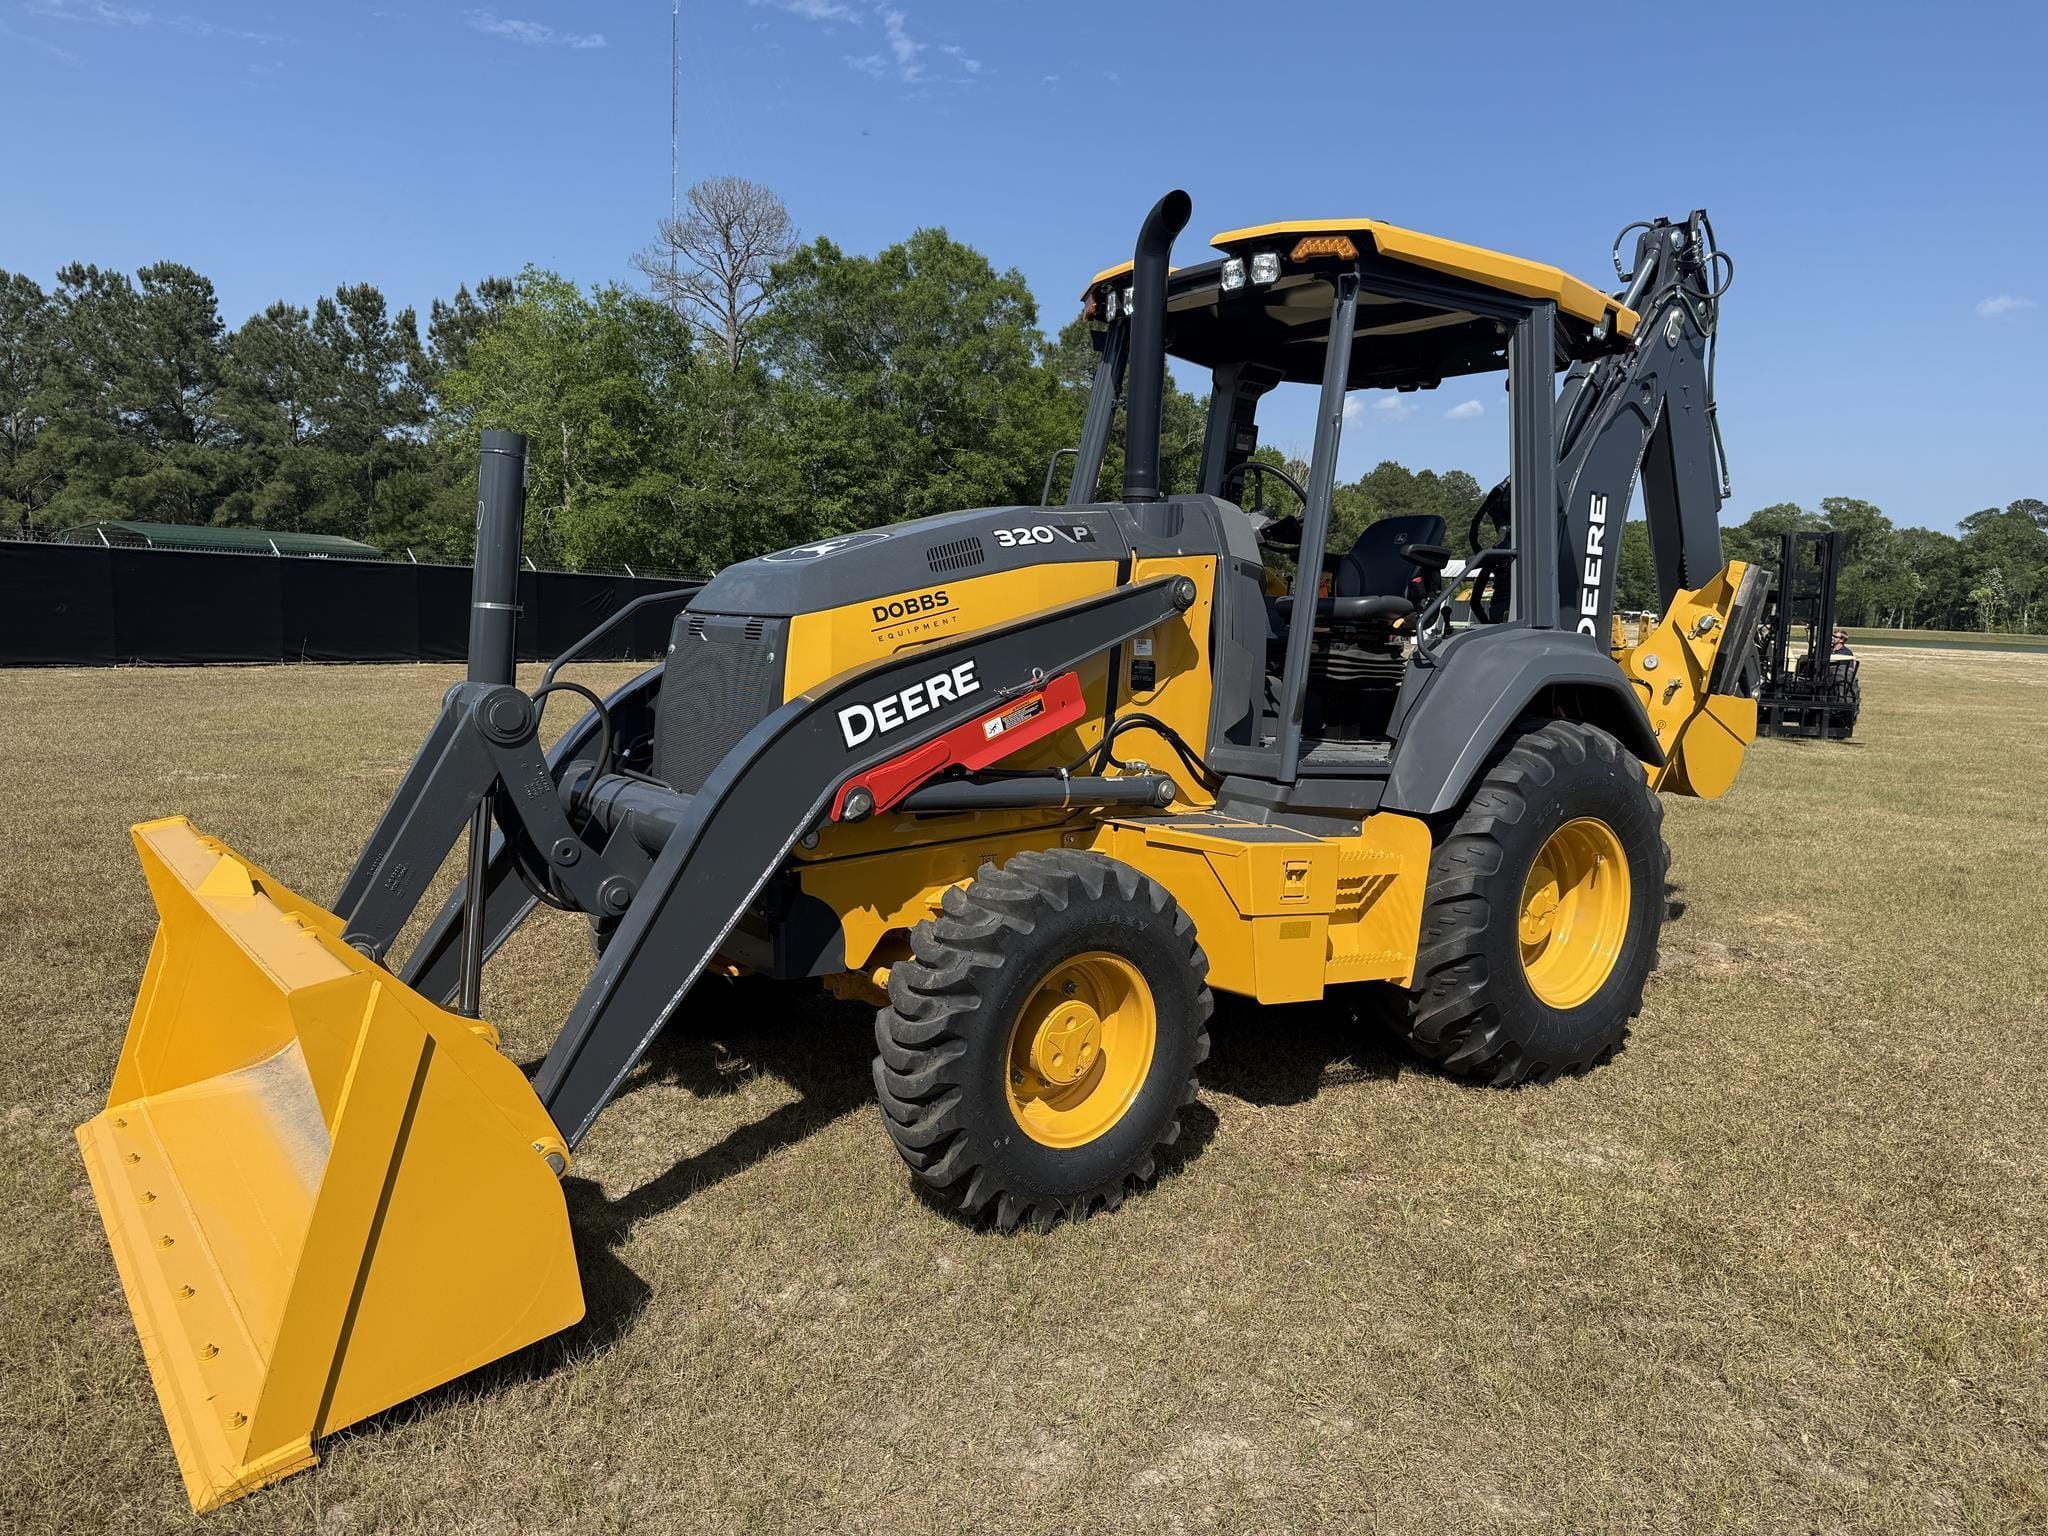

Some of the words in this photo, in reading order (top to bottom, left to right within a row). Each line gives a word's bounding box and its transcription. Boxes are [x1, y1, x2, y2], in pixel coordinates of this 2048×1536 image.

[993, 526, 1054, 547] 320
[1072, 526, 1088, 541] P
[1577, 494, 1607, 638] DEERE
[872, 591, 949, 623] DOBBS
[878, 616, 957, 642] EQUIPMENT
[838, 660, 980, 748] DEERE
[1069, 914, 1152, 933] GALAXY
